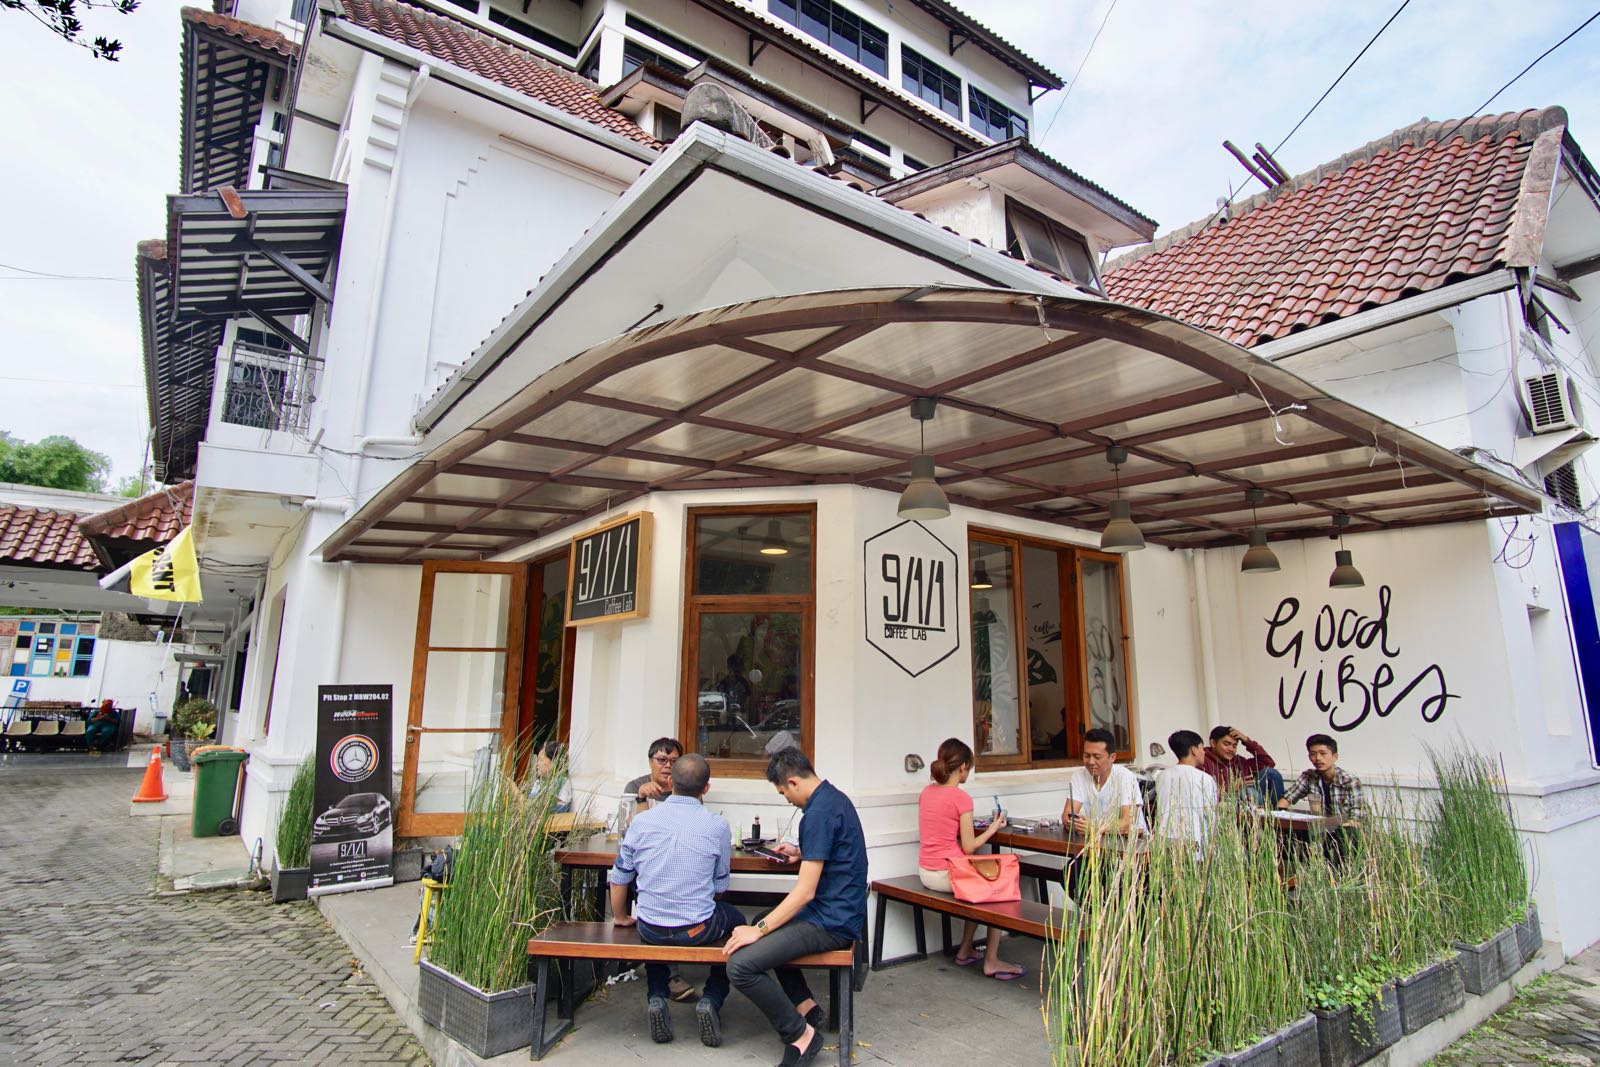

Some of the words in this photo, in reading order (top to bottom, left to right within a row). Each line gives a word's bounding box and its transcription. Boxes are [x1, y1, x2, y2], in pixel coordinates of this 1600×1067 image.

[604, 598, 622, 615] Coffee
[622, 595, 633, 612] Lab
[884, 628, 908, 639] COFFEE
[912, 629, 927, 641] LAB
[1264, 585, 1400, 668] Good
[16, 681, 27, 691] P
